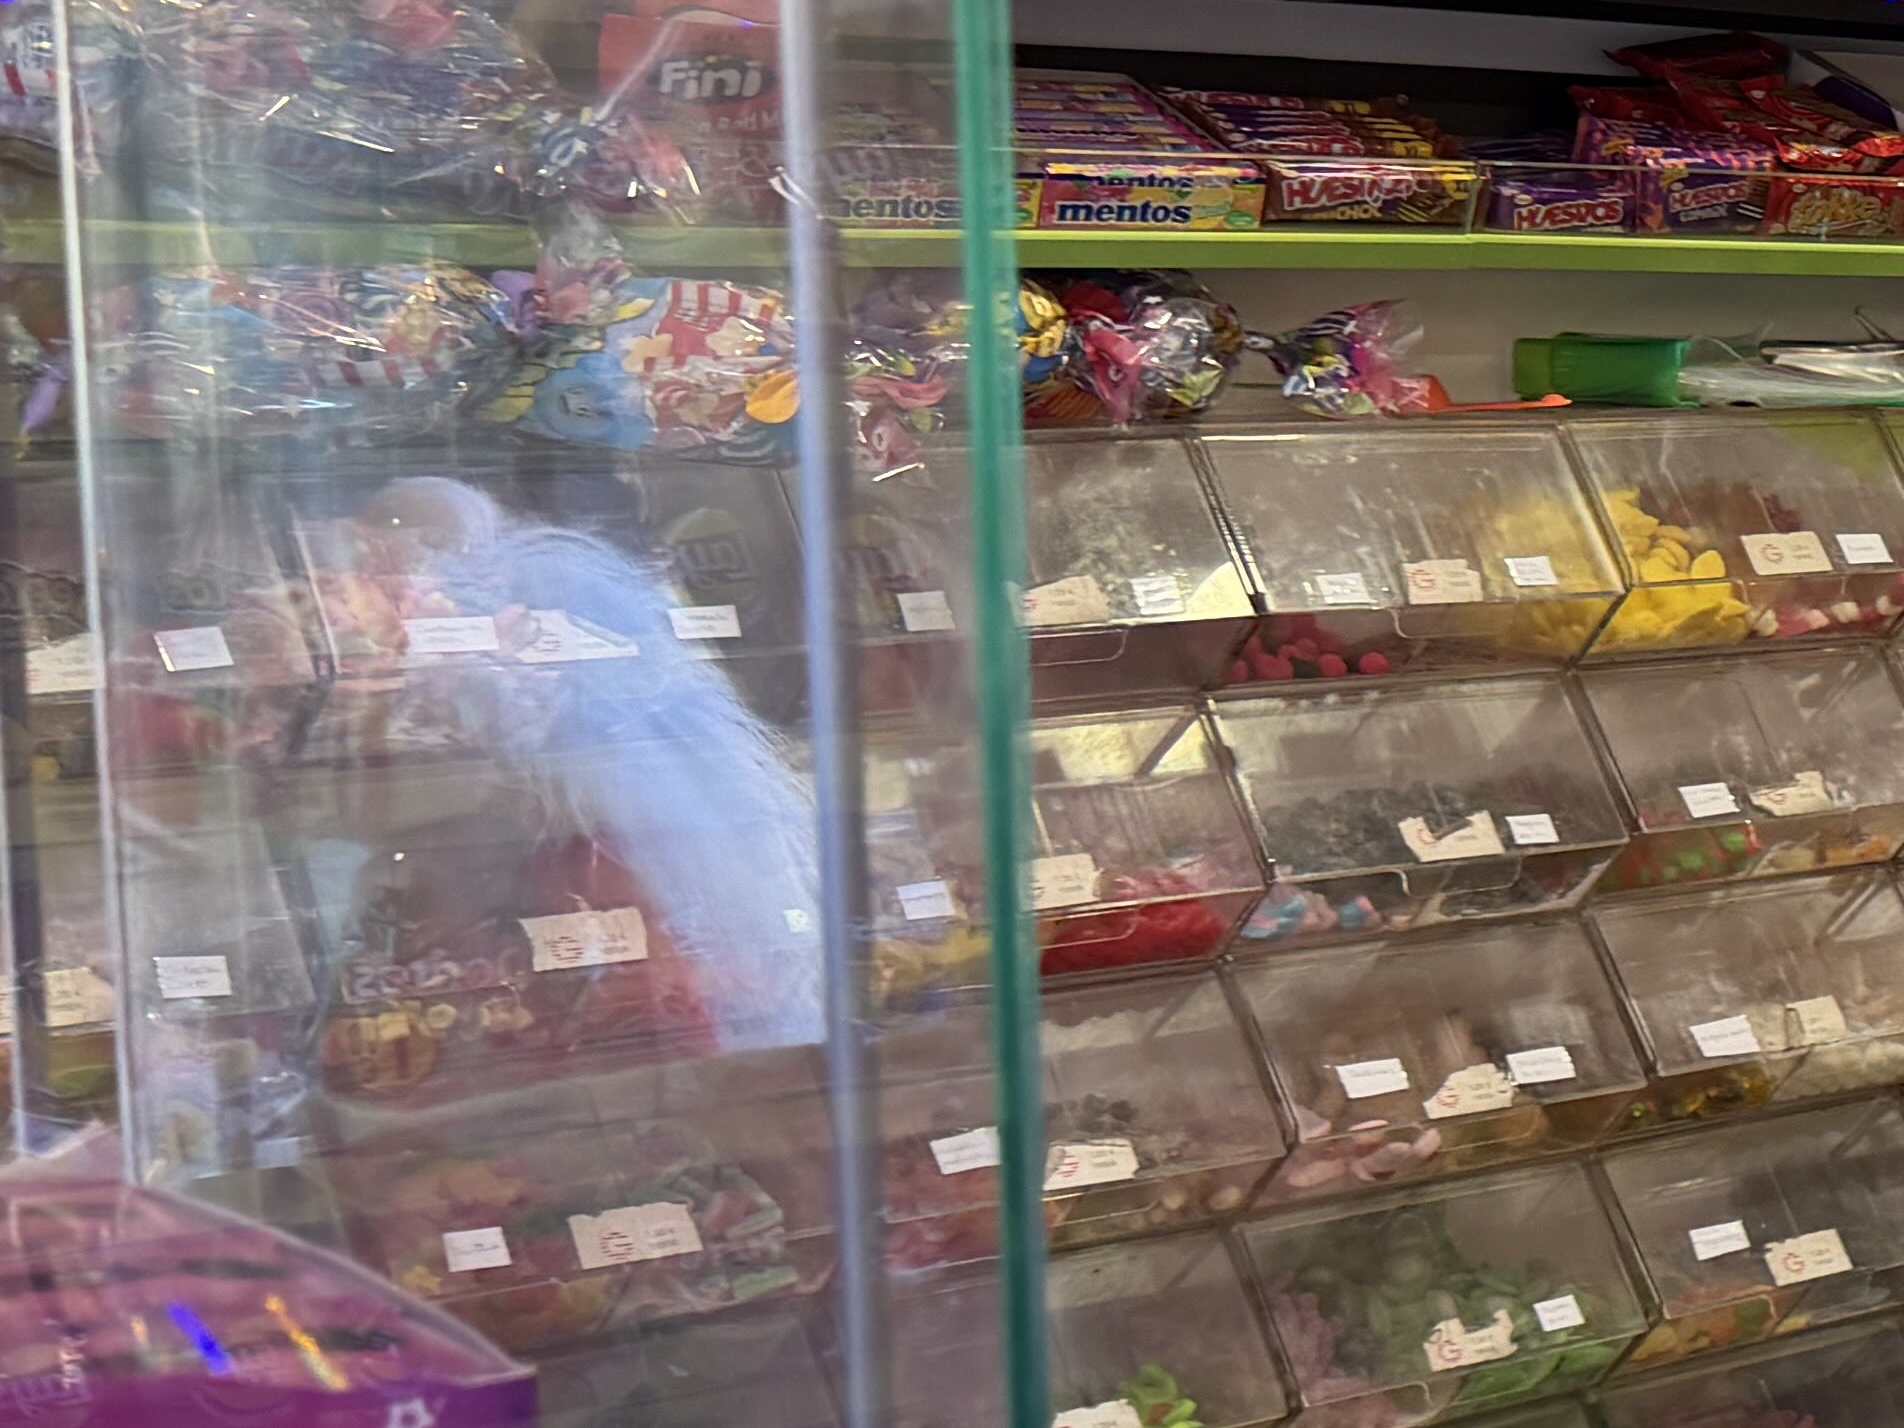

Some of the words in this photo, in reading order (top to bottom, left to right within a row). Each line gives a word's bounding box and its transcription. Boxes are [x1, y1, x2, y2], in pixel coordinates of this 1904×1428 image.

[658, 58, 764, 102] Fini
[1056, 199, 1193, 225] mentos
[1513, 197, 1625, 231] HUESITOS
